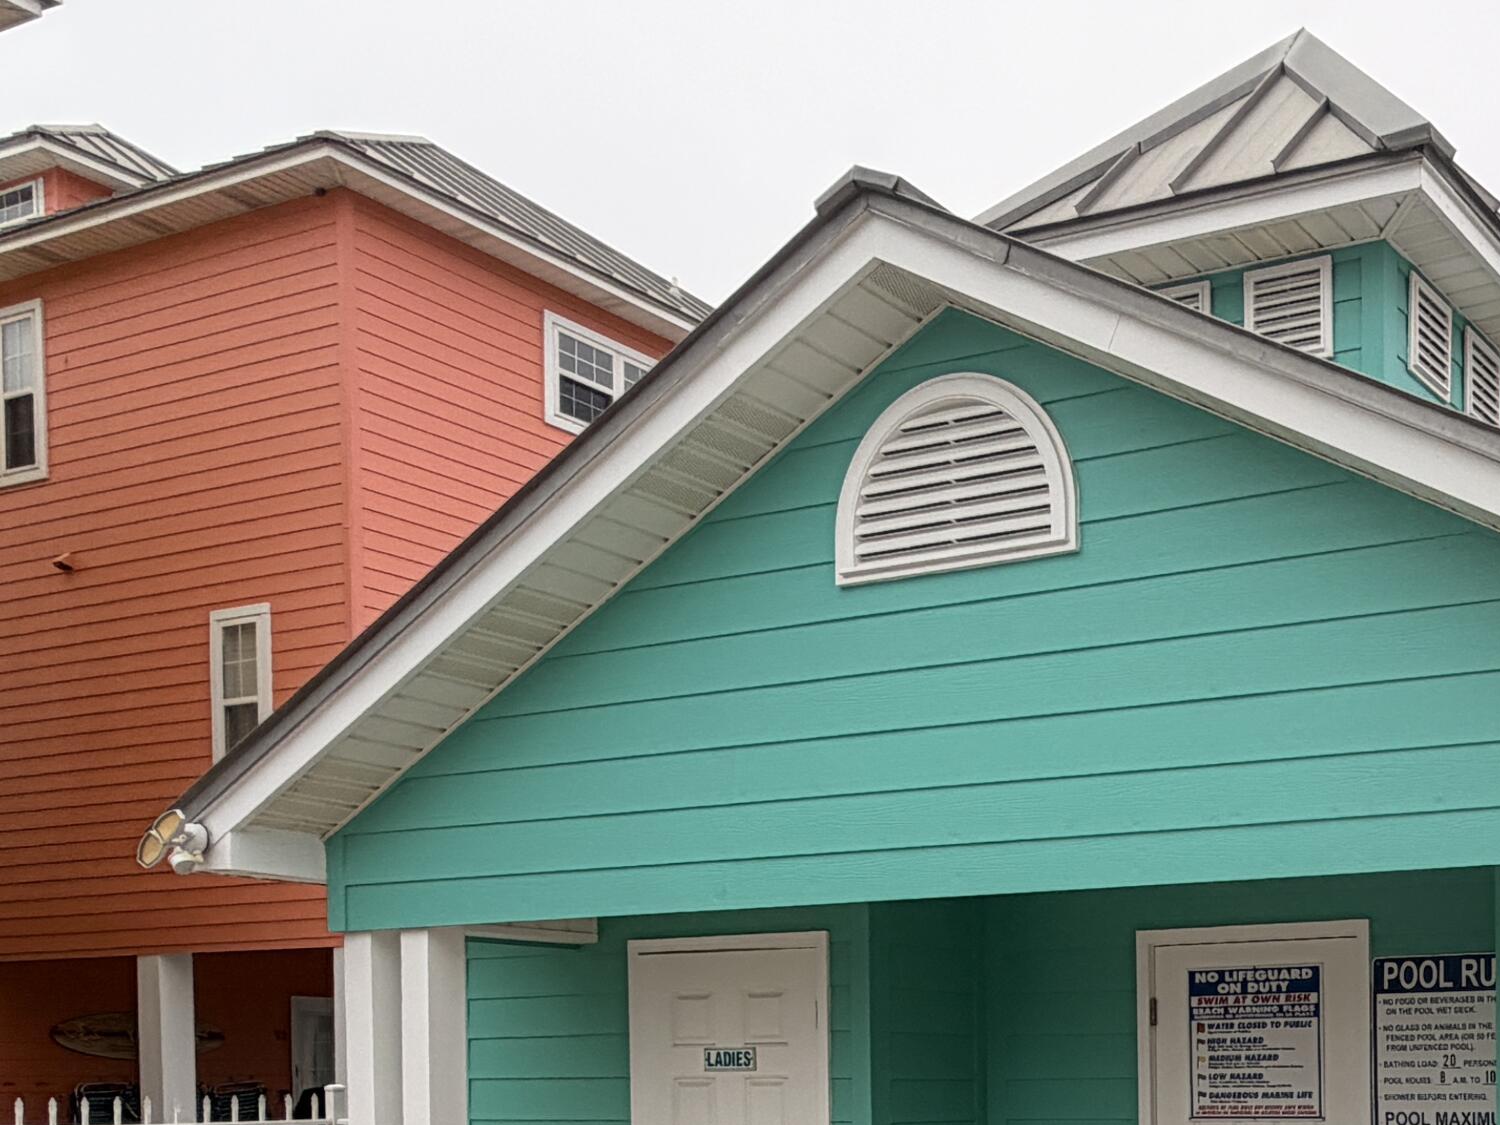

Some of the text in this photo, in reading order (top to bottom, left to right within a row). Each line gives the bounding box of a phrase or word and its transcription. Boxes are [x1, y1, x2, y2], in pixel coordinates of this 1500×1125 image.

[1195, 968, 1313, 983] NO LIFEGUARD
[1383, 960, 1454, 990] POOL
[1217, 981, 1289, 994] ON DUTY
[1197, 994, 1311, 1005] SWIM AT OWN RISK
[706, 1050, 752, 1067] LADIES
[1443, 1054, 1456, 1067] 20
[1485, 1070, 1496, 1083] 10
